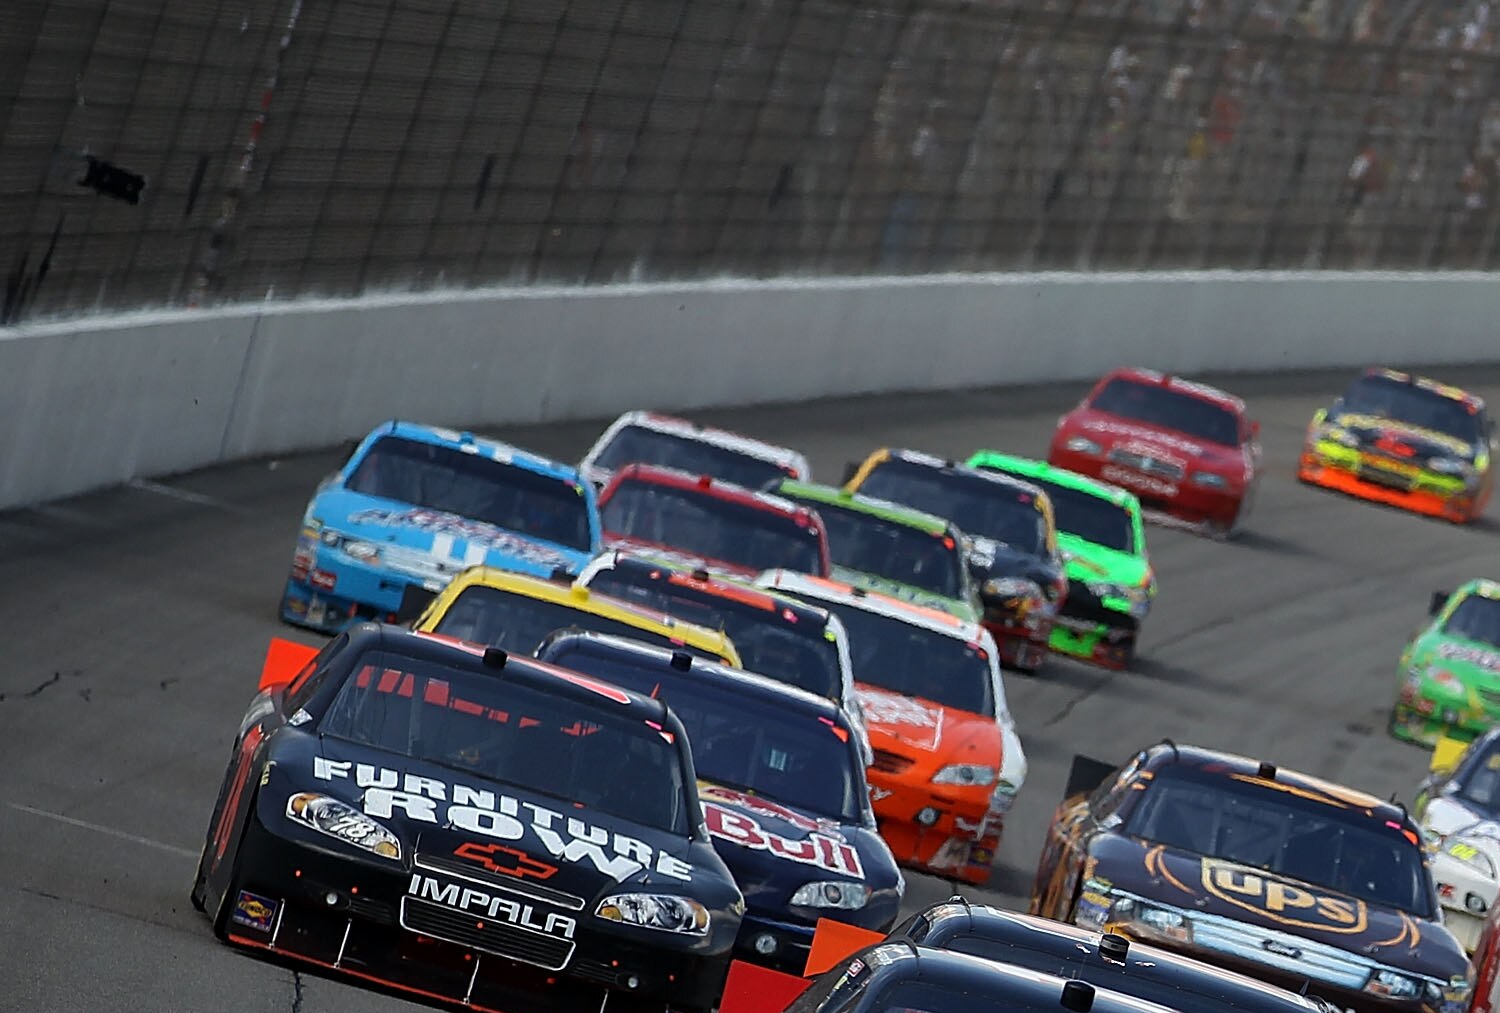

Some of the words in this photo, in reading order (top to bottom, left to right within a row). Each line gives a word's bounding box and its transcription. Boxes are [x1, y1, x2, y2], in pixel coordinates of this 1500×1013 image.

[314, 756, 692, 881] FURNITURE
[330, 815, 375, 841] 78
[364, 787, 643, 884] ROW
[700, 800, 865, 880] Bull
[408, 874, 576, 939] IMPALA
[1215, 867, 1356, 925] ups
